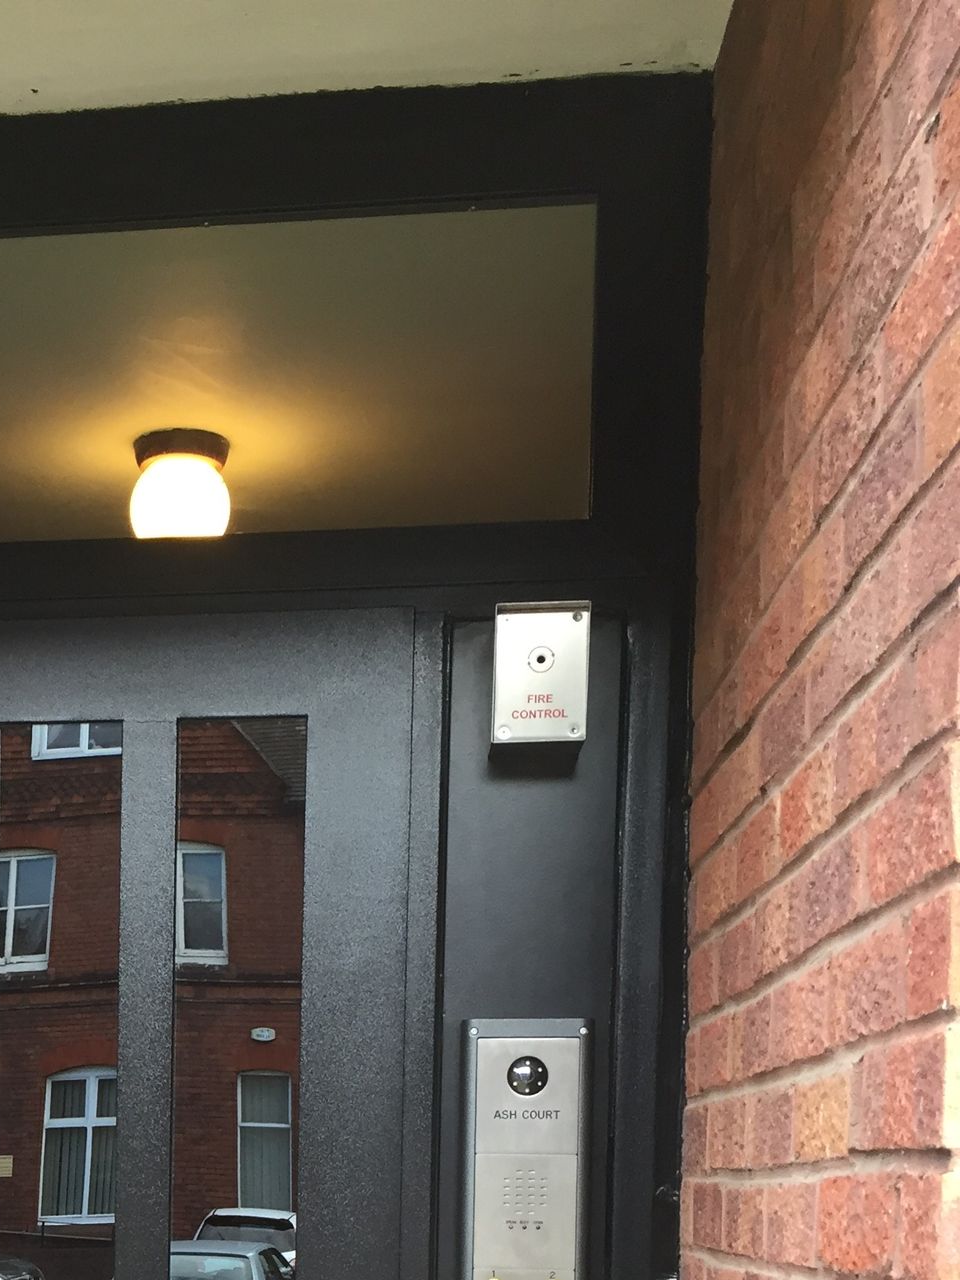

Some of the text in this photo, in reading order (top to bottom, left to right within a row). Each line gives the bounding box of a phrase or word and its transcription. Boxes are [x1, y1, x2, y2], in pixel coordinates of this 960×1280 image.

[527, 694, 553, 703] FIRE
[511, 709, 568, 719] CONTROL
[493, 1110, 560, 1119] ASH COURT
